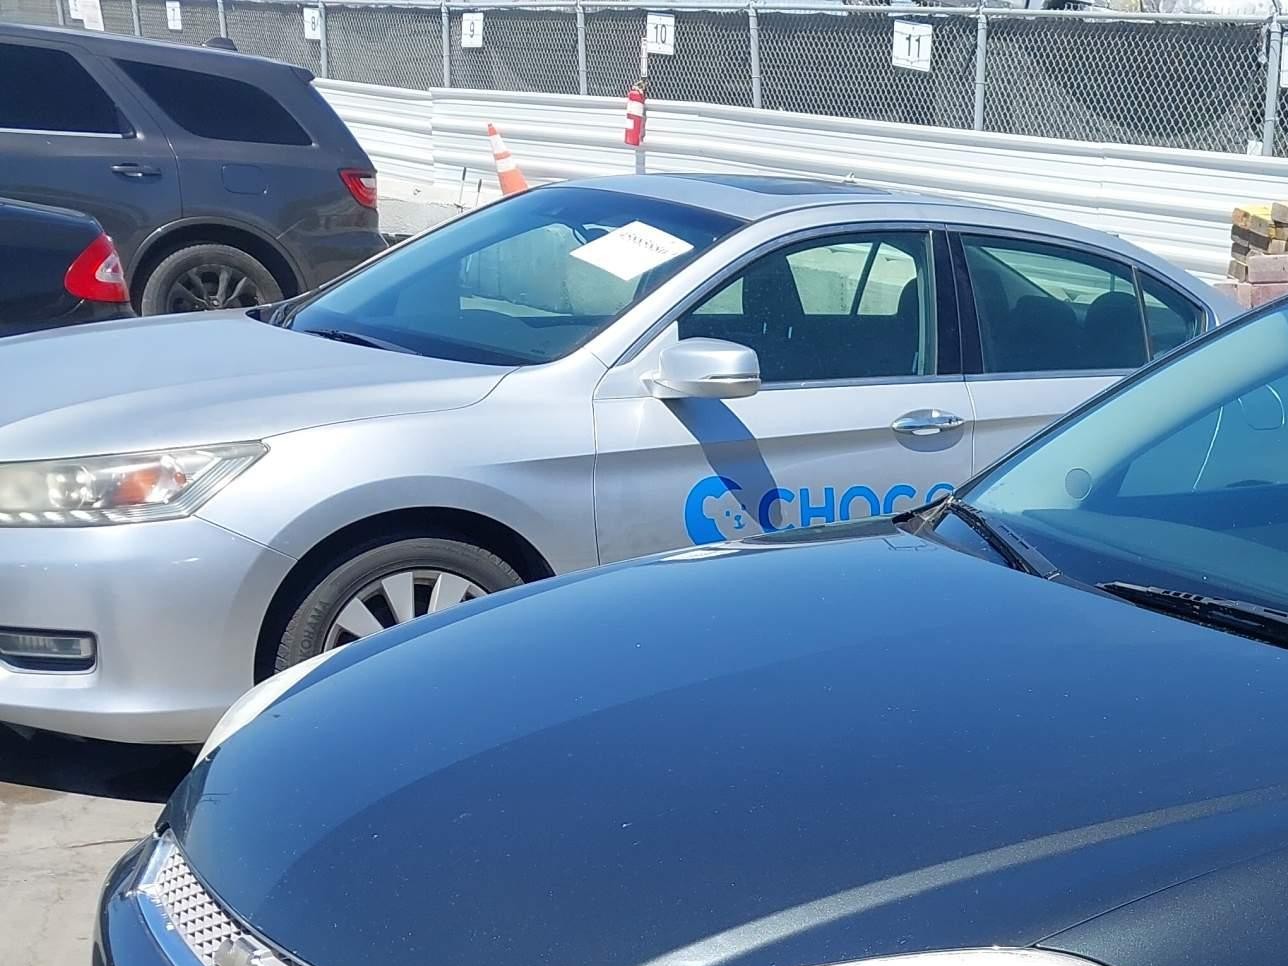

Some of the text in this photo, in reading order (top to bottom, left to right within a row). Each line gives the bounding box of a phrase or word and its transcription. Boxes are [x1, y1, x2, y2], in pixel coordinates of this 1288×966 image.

[311, 16, 316, 31] 8
[469, 21, 475, 38] 9
[654, 24, 667, 44] 10
[906, 34, 921, 58] 11
